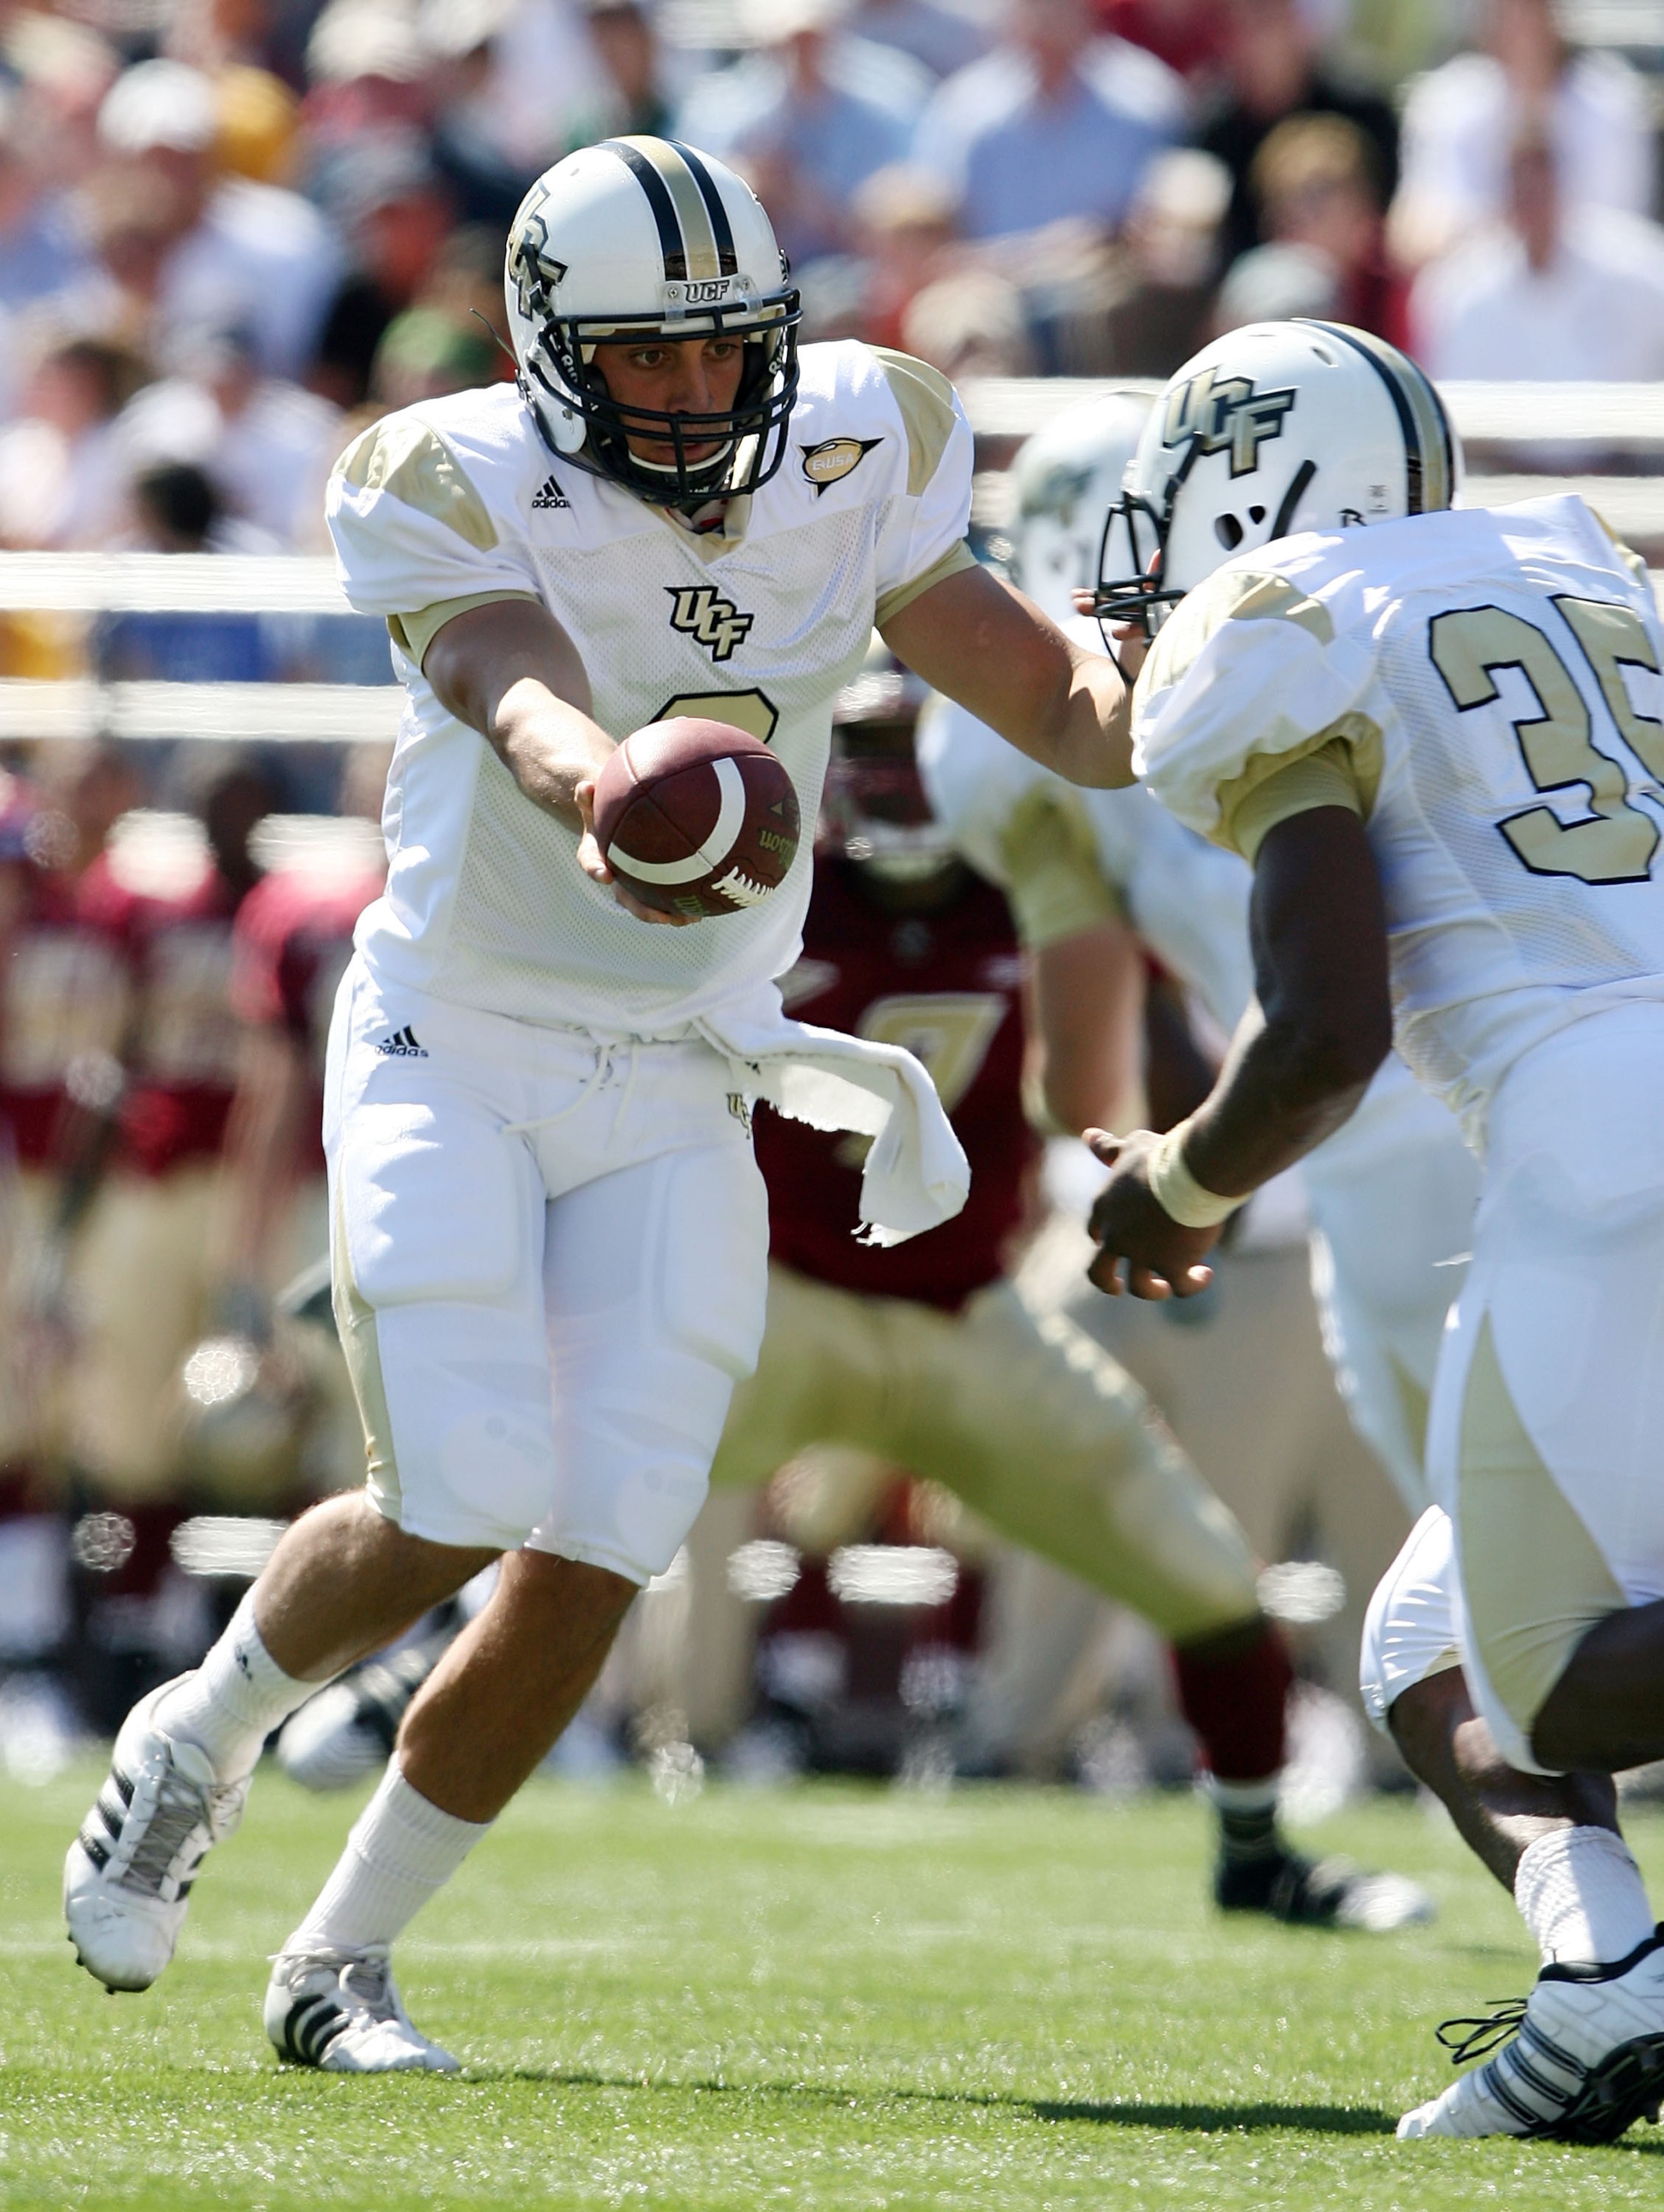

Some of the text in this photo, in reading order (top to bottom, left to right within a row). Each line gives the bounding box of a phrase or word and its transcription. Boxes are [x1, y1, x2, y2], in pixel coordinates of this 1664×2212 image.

[683, 280, 730, 303] UCF
[1162, 366, 1297, 478] UCF
[663, 585, 754, 662] UCF
[1428, 593, 1664, 886] 35
[375, 1044, 429, 1057] adidas
